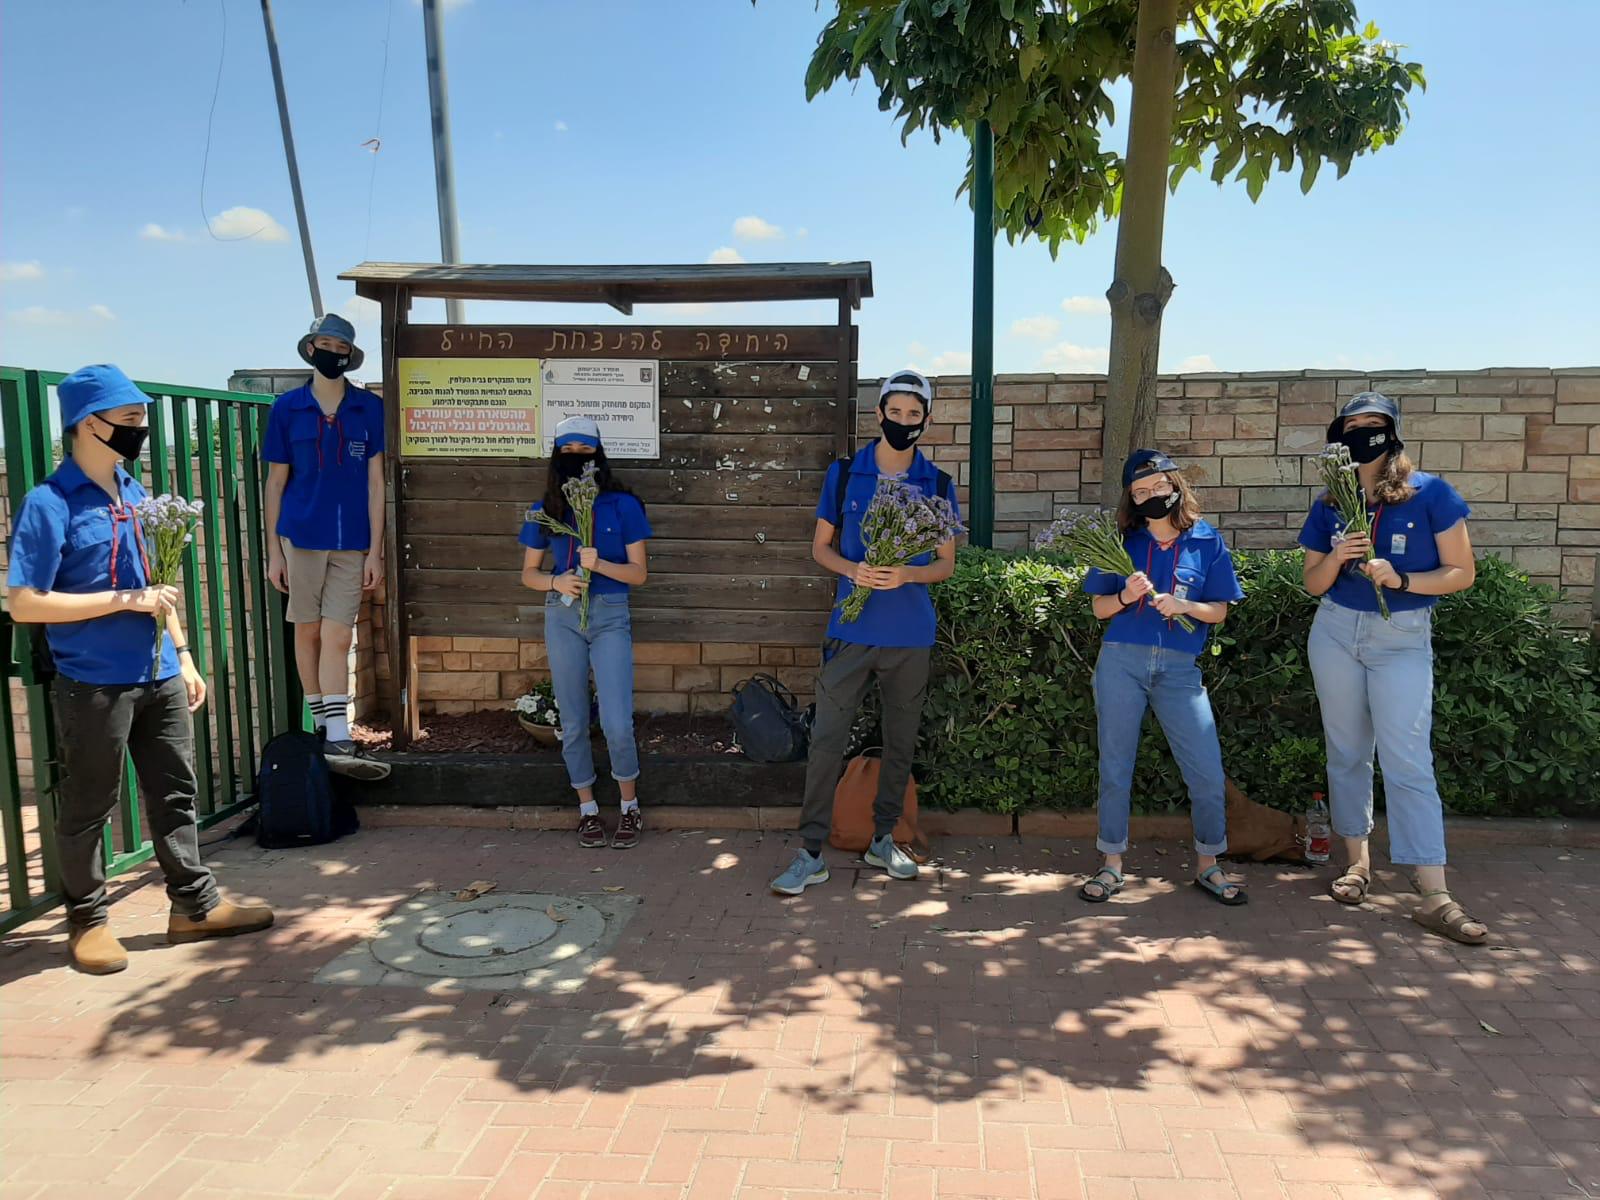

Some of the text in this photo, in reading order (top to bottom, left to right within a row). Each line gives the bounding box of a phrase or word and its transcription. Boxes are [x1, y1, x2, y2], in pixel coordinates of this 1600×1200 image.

[440, 329, 788, 353] היחידה להנצחת החייל
[456, 388, 479, 396] המשרד
[576, 399, 600, 408] ומטופל
[601, 400, 628, 410] מתוחזק
[629, 401, 651, 410] המקום
[413, 408, 526, 419] מהשארת מים עומדים
[611, 414, 635, 422] היחידה
[410, 418, 532, 432] באגרטלים ובכלי הקיבול
